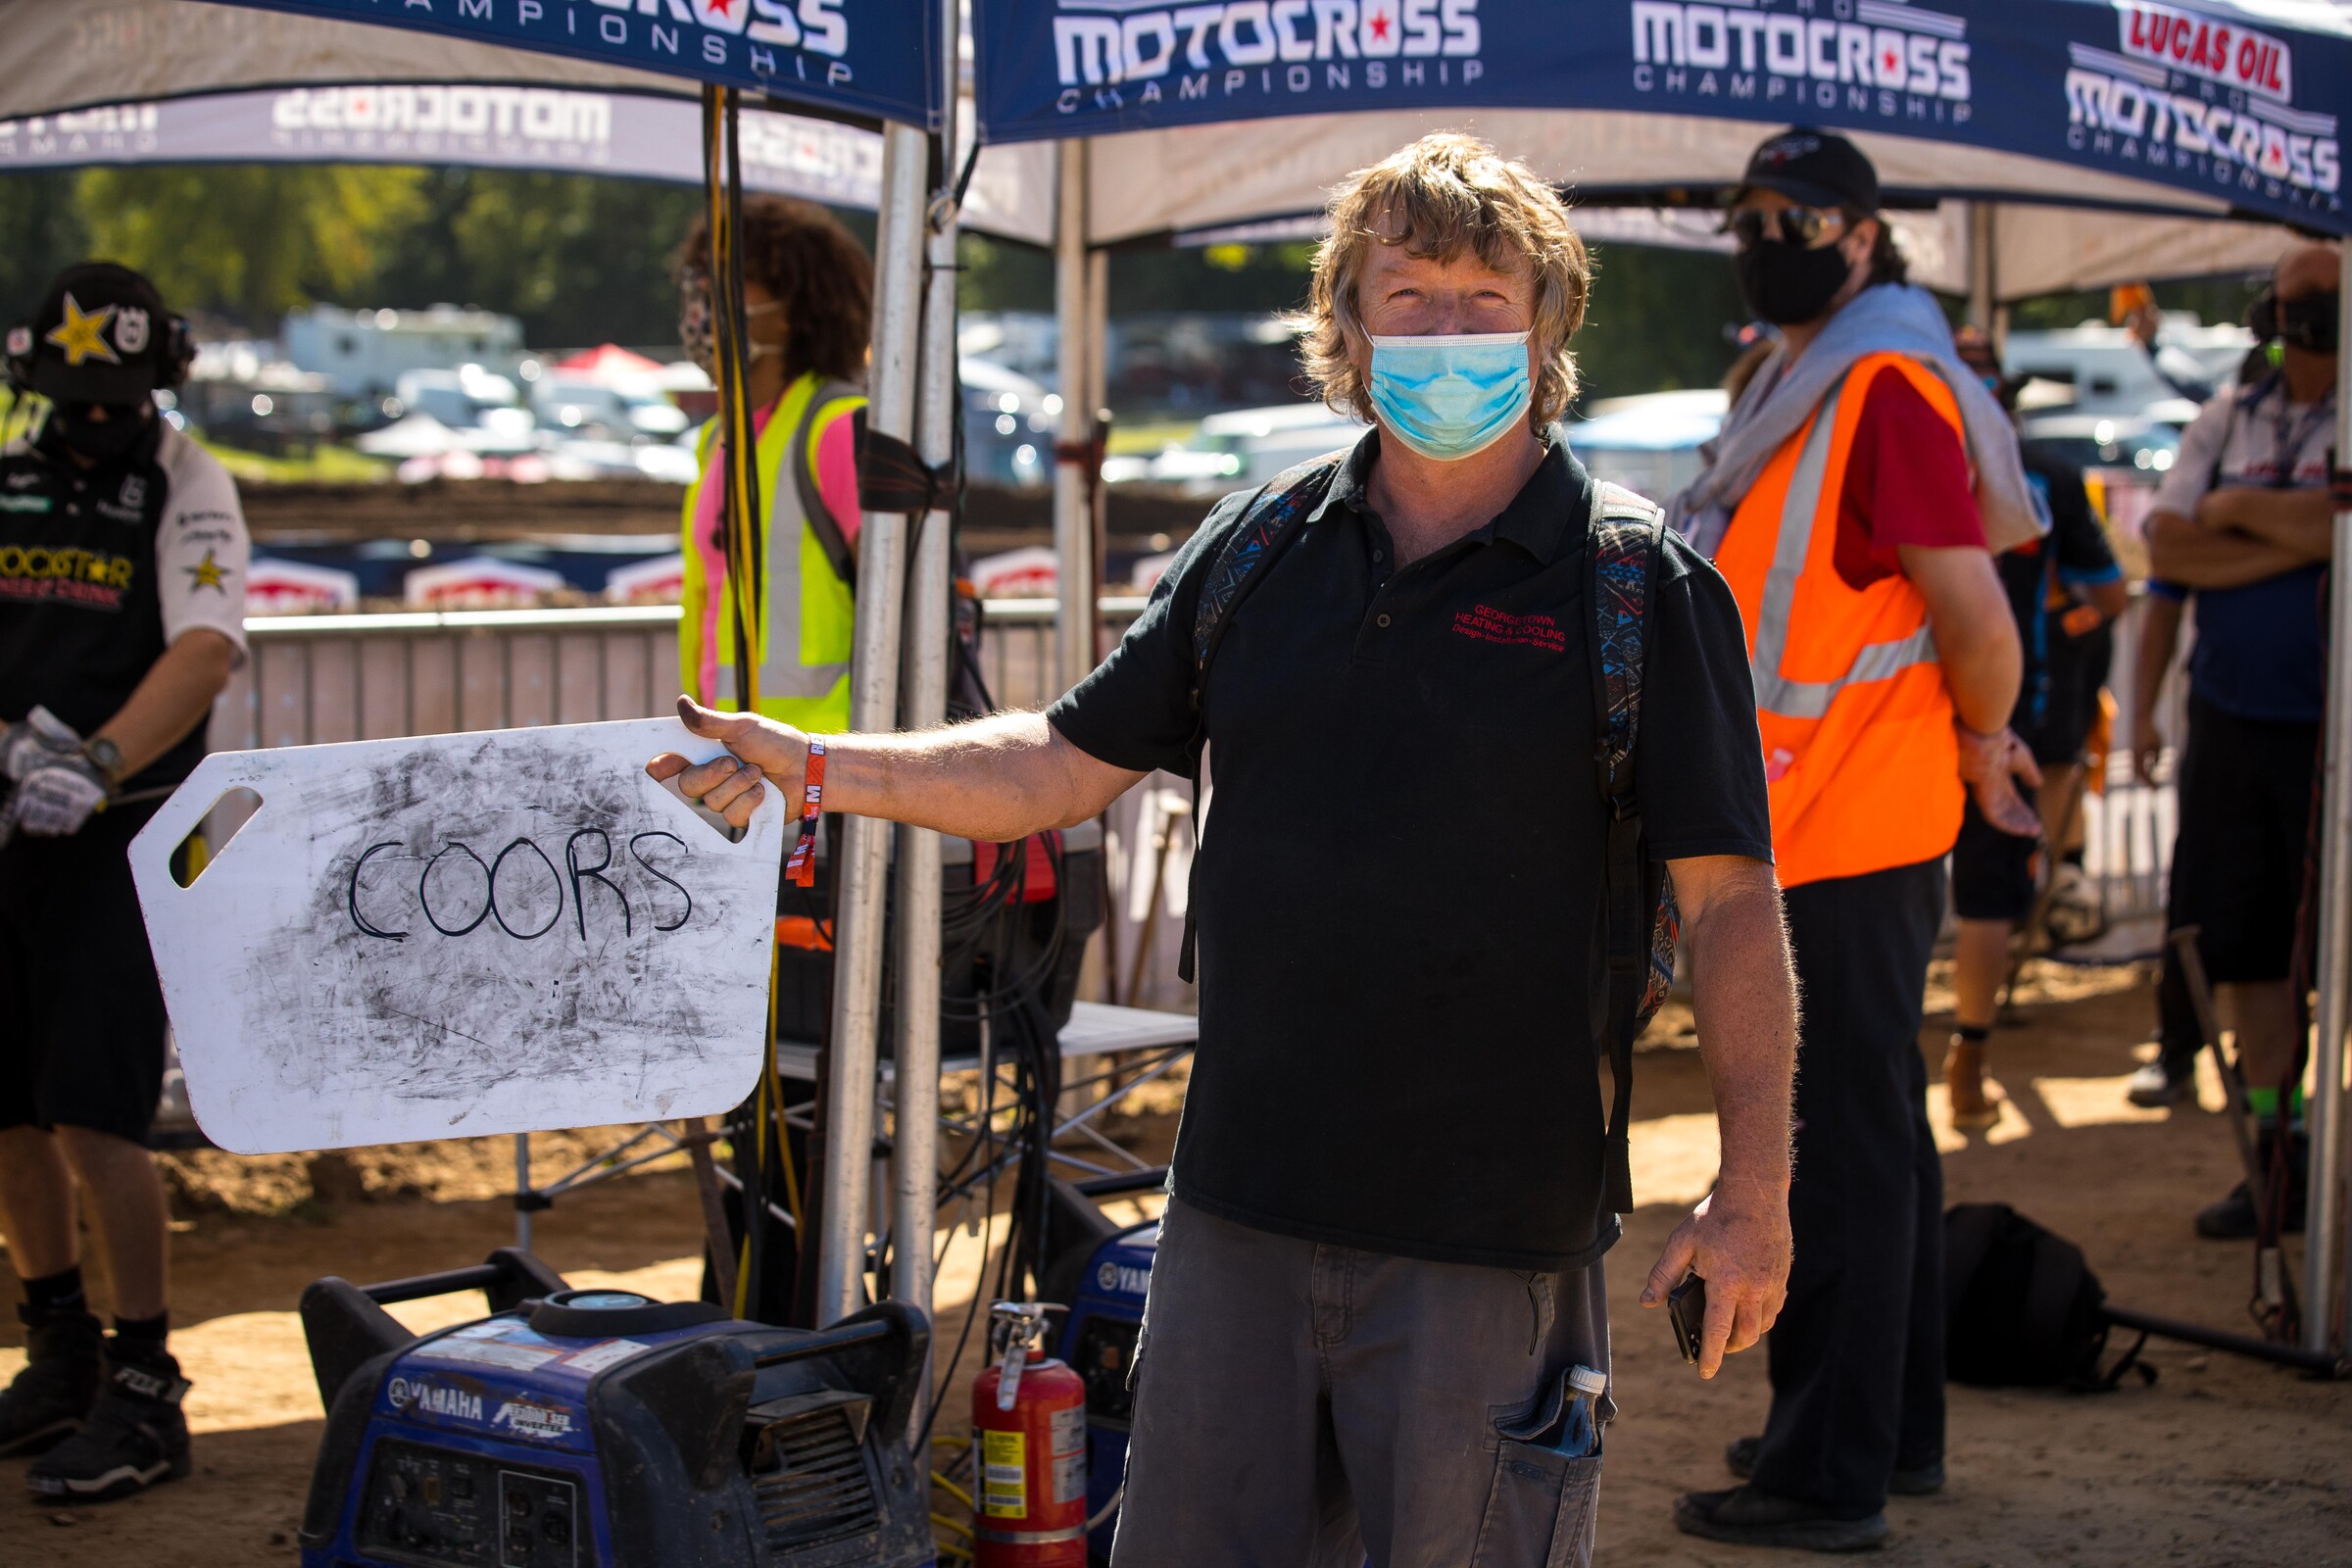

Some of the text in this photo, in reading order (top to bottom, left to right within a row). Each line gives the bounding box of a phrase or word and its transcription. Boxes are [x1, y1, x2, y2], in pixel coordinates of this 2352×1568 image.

[367, 0, 853, 86] MPIONSHIP
[1054, 0, 1482, 85] MOTOCROSS
[1632, 0, 1971, 100] MOTOCROSS
[2131, 7, 2282, 92] LUCAS OIL
[1056, 60, 1484, 114] CHAMPIONSHIP
[1634, 64, 1973, 124] CHAMPIONSHIP
[2065, 66, 2341, 193] MOTOCROSS
[2067, 123, 2343, 213] CHAMPIONSHIP
[1454, 612, 1566, 643] HEATING & COOLING
[1474, 604, 1555, 627] GEORGETOWN
[348, 827, 693, 944] COORS
[410, 1381, 483, 1422] YAMAHA
